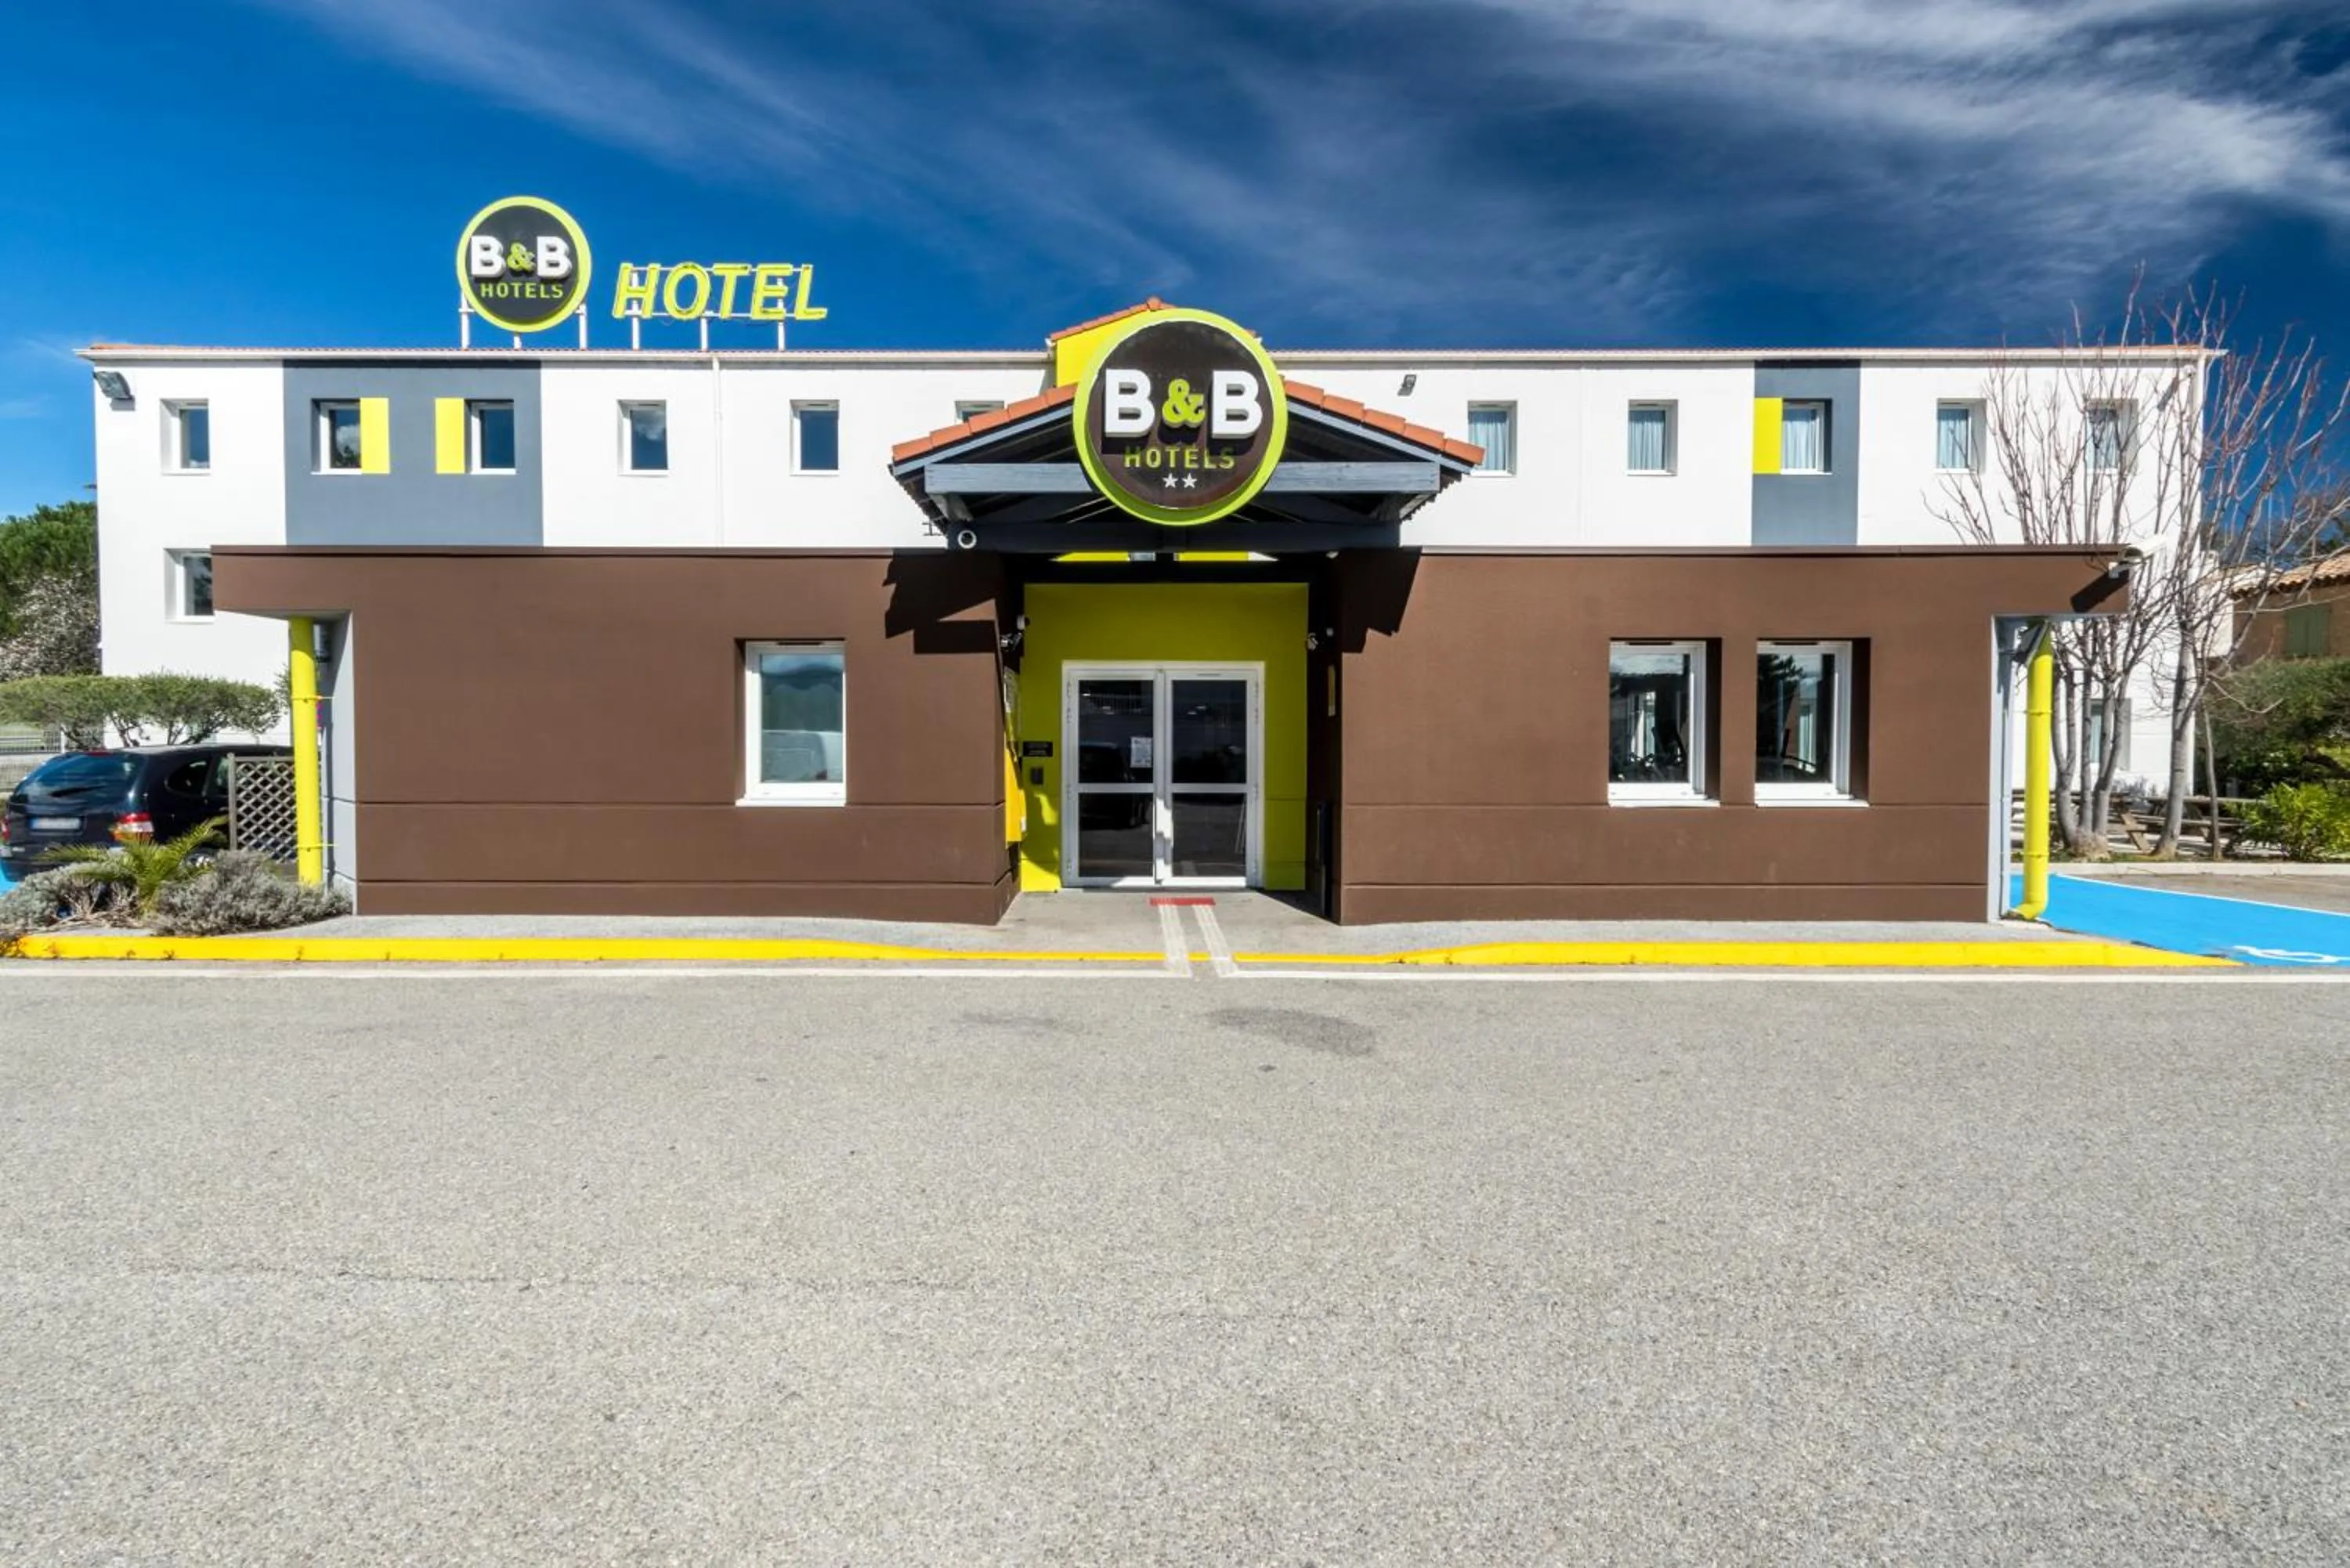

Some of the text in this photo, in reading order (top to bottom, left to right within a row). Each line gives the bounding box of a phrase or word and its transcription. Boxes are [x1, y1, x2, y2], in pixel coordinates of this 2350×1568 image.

[470, 236, 573, 280] B&B
[480, 281, 563, 299] HOTELS
[613, 262, 827, 320] HOTEL
[1104, 368, 1264, 439] B&B
[1123, 446, 1236, 470] HOTELS
